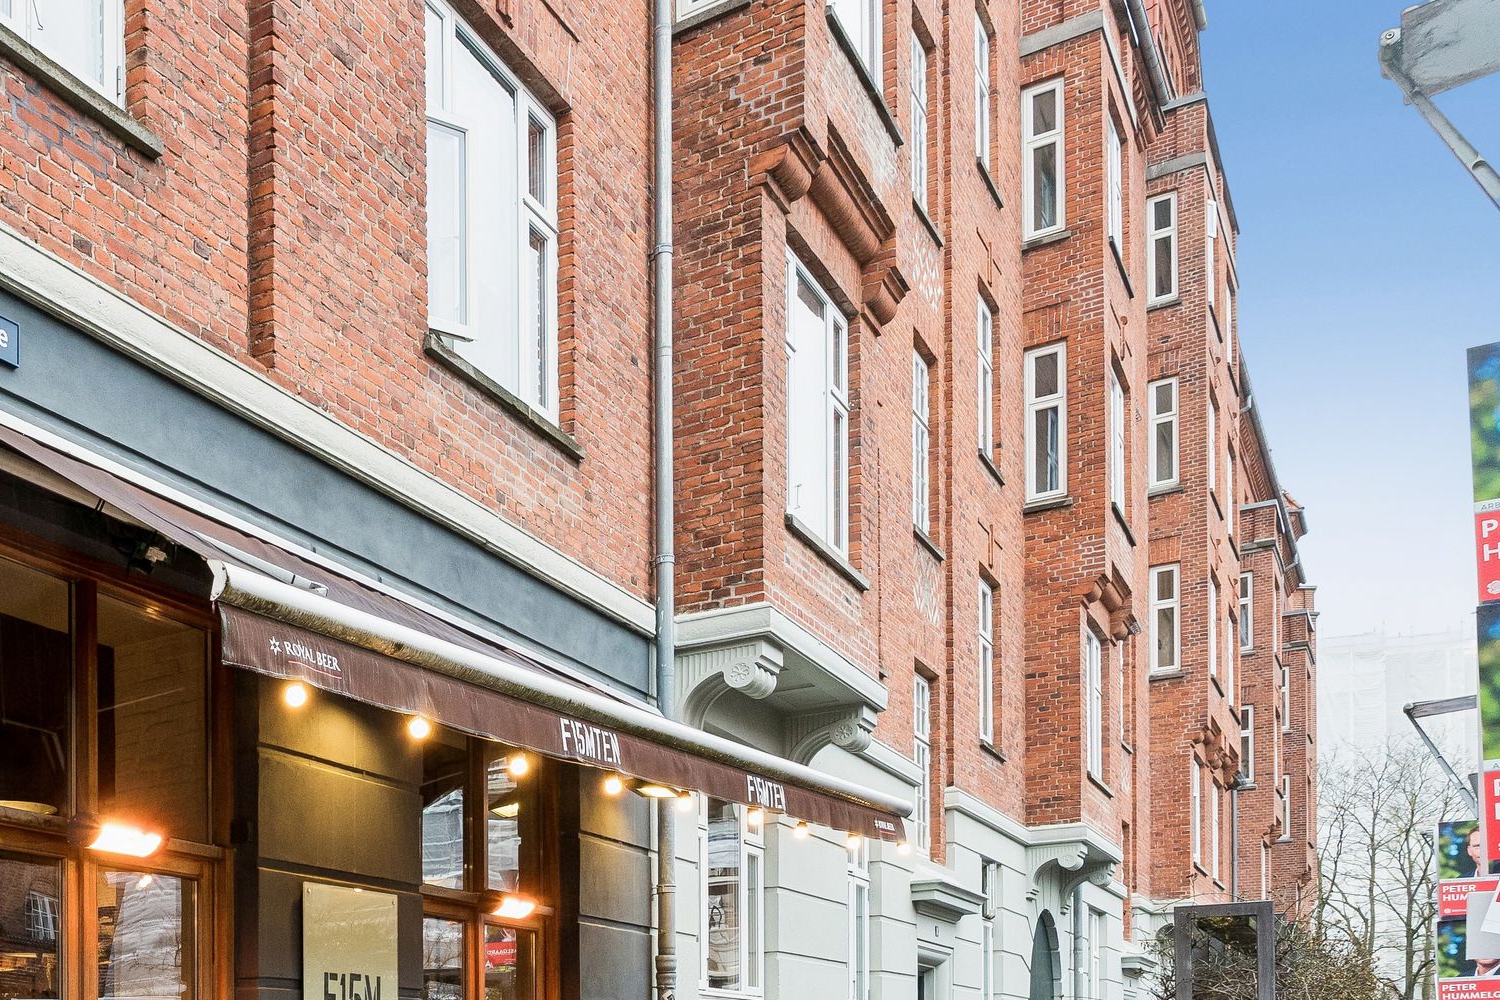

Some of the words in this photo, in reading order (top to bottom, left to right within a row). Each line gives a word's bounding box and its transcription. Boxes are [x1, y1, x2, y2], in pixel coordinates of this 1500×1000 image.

[283, 641, 316, 663] ROYAL
[316, 652, 341, 671] BEER
[560, 717, 621, 764] F15MTEN
[1442, 884, 1476, 893] PETER
